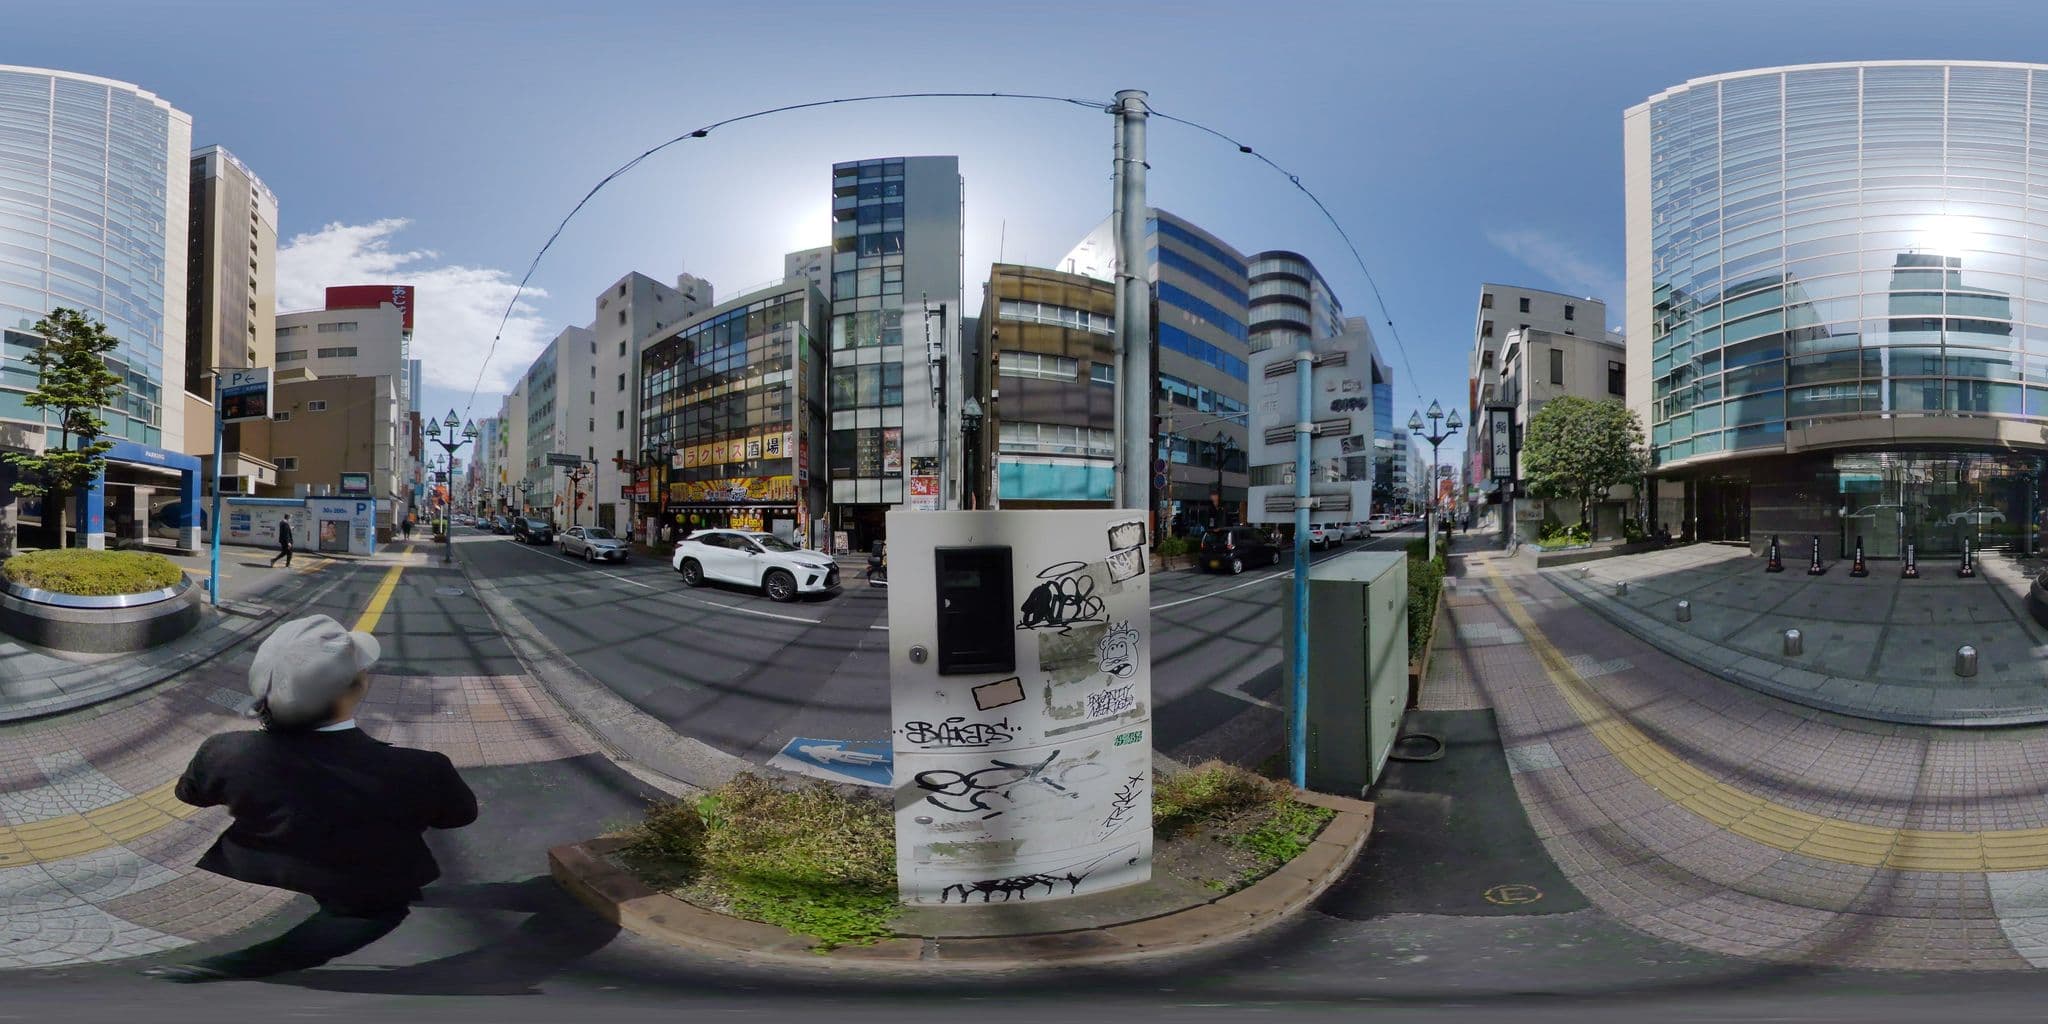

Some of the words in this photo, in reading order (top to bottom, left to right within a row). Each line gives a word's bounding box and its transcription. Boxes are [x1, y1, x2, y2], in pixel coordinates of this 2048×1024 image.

[232, 373, 242, 385] P
[145, 450, 165, 460] PARKING
[687, 437, 779, 461] ラクヤス酒場
[356, 502, 367, 515] P
